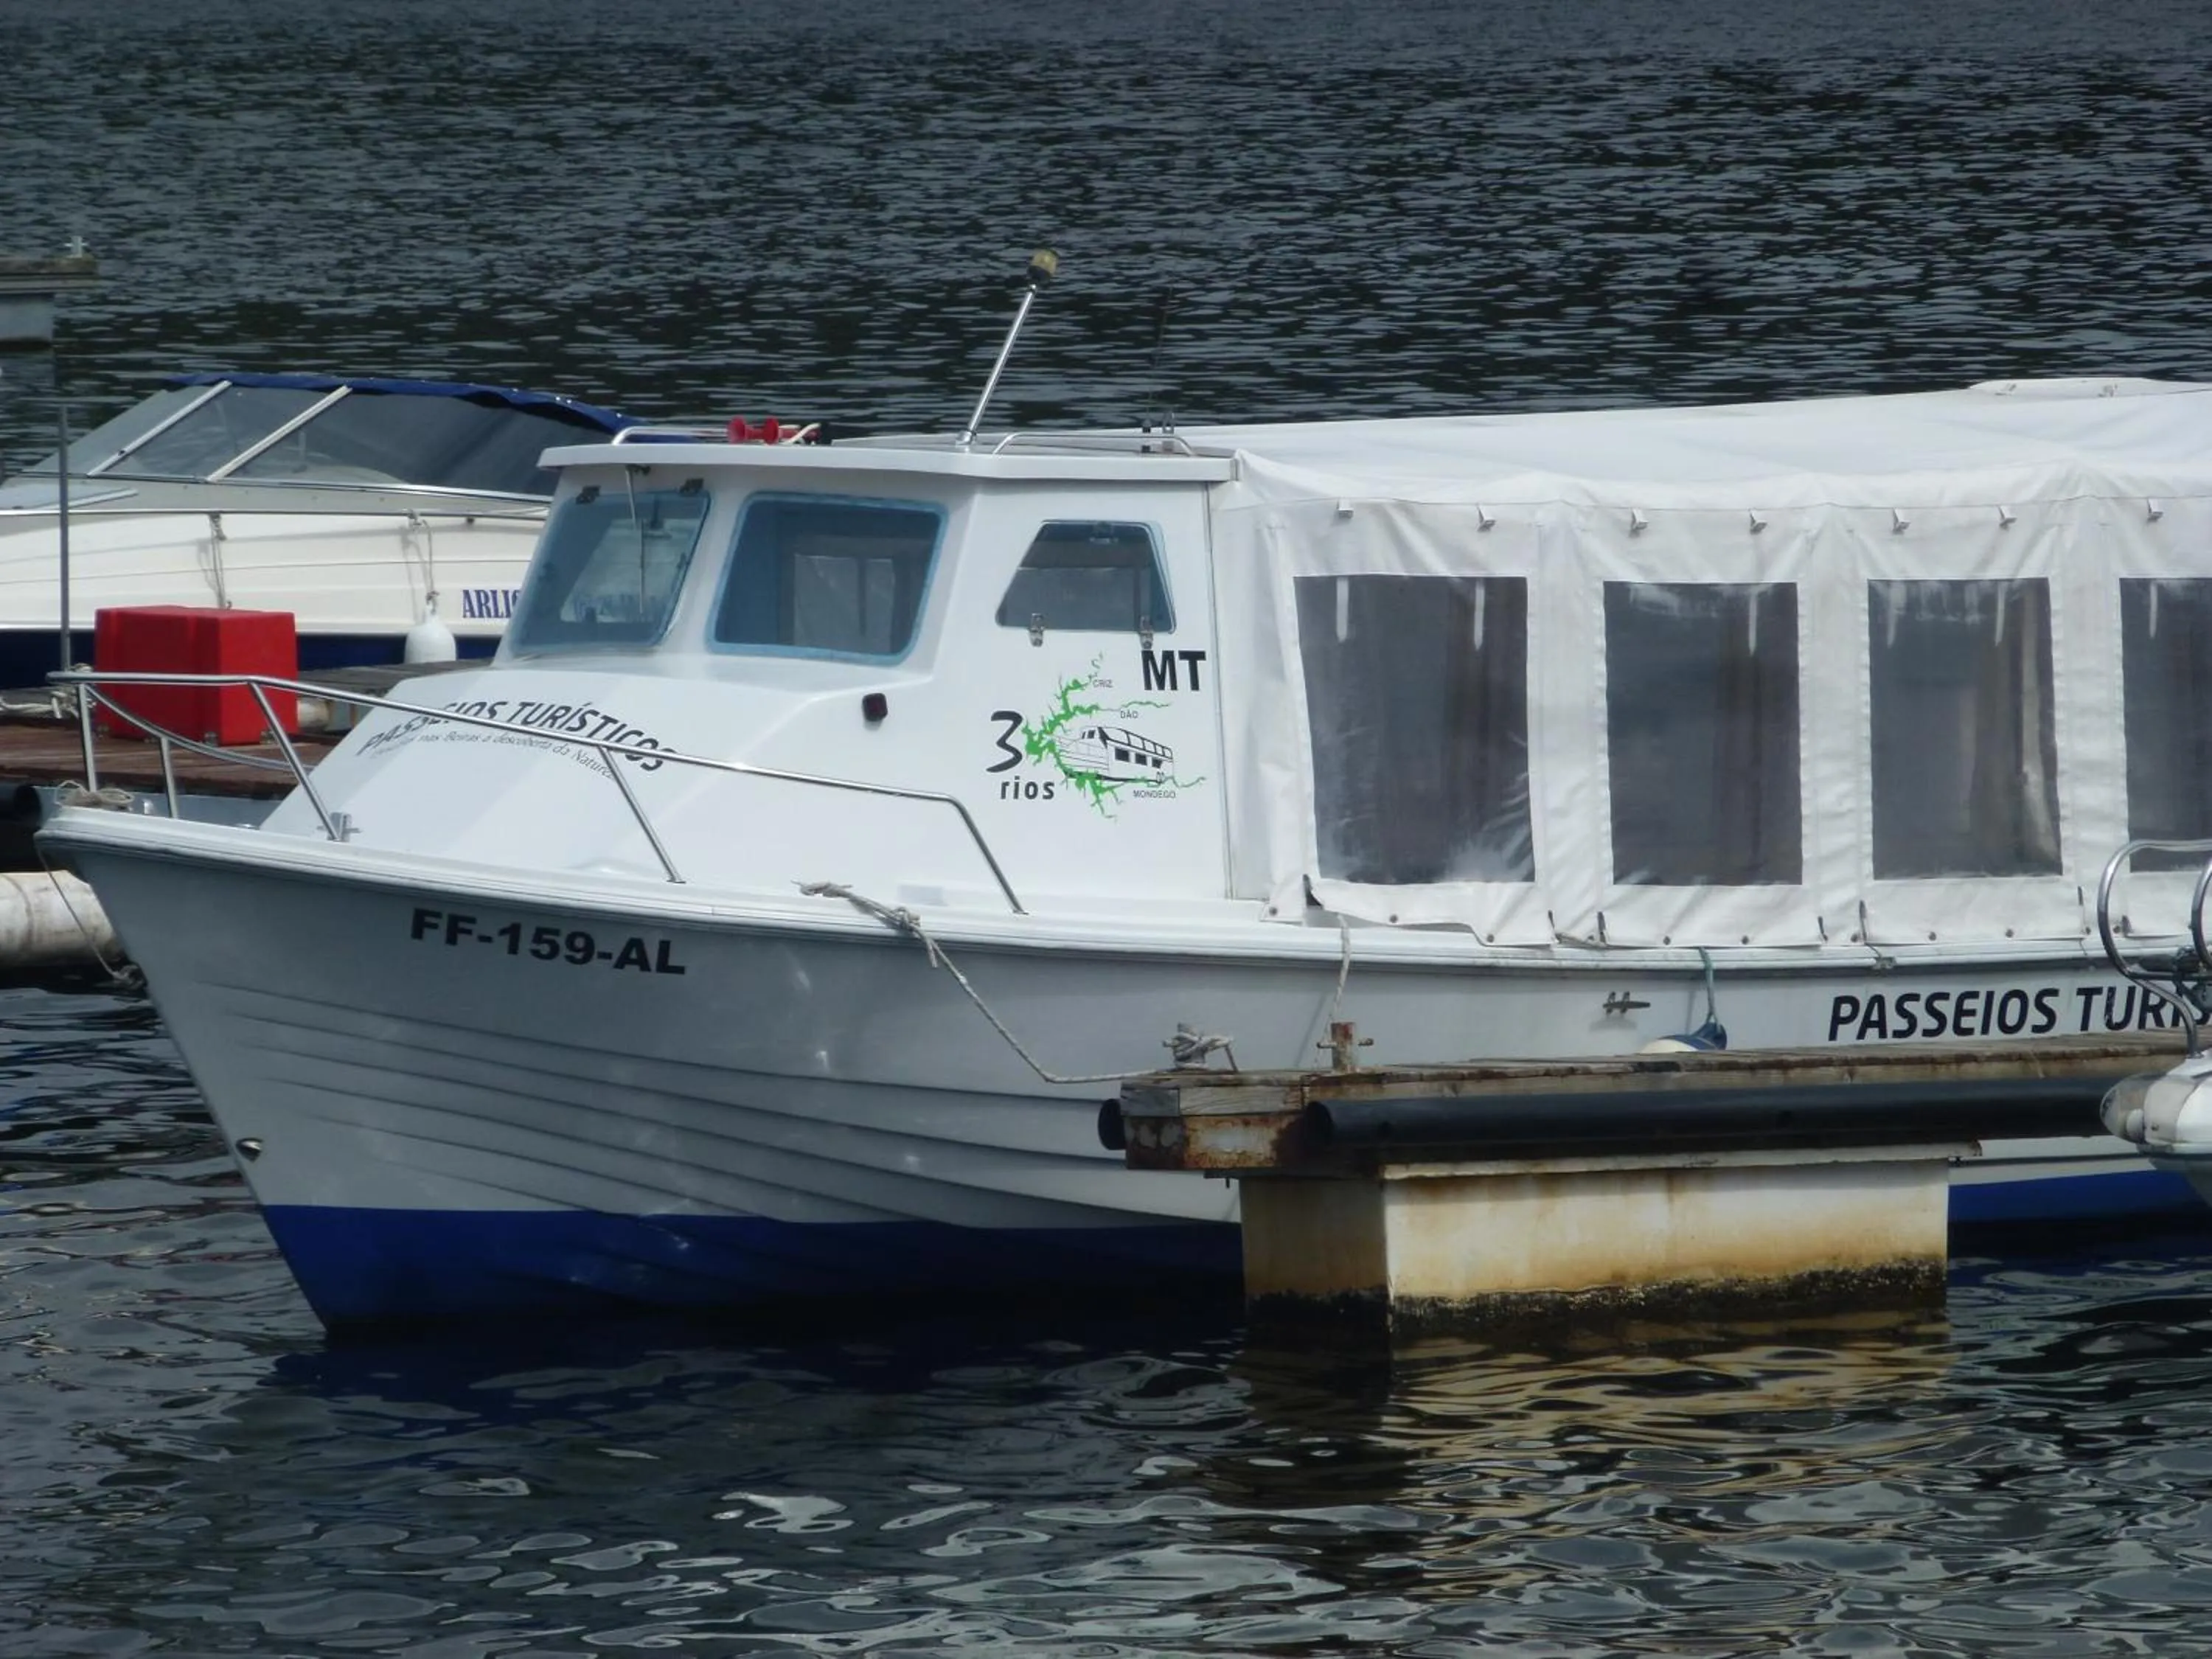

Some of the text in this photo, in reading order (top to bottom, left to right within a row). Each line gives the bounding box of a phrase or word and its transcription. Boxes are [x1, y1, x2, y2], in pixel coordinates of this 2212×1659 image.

[1141, 650, 1206, 692] MT
[986, 710, 1023, 773] 3
[1001, 776, 1055, 800] rios
[1133, 790, 1176, 799] MONDEGO
[411, 908, 686, 975] FF-159-AL
[1828, 988, 2059, 1041] PASSEIOS
